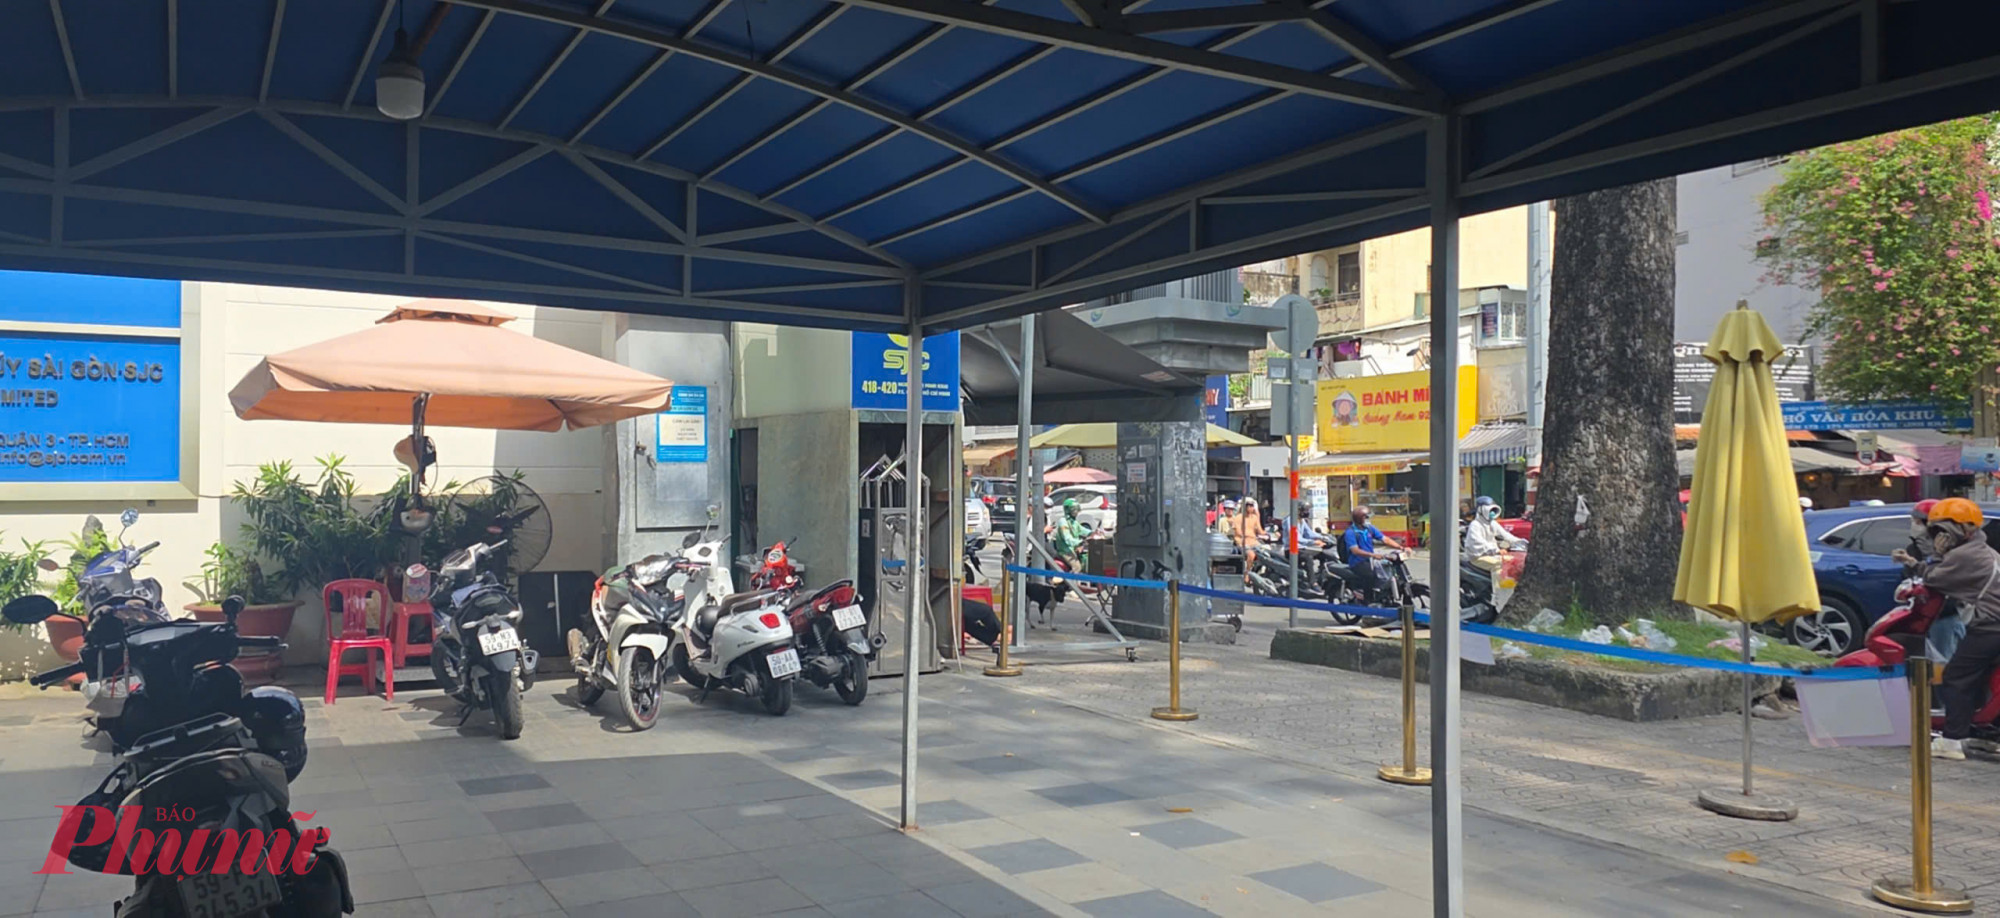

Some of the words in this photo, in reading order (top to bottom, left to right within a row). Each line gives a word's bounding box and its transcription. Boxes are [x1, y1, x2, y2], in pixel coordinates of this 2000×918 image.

[28, 353, 63, 380] SÀI
[862, 380, 897, 394] 418-420
[1362, 388, 1409, 406] BÁNH
[46, 433, 57, 448] 3
